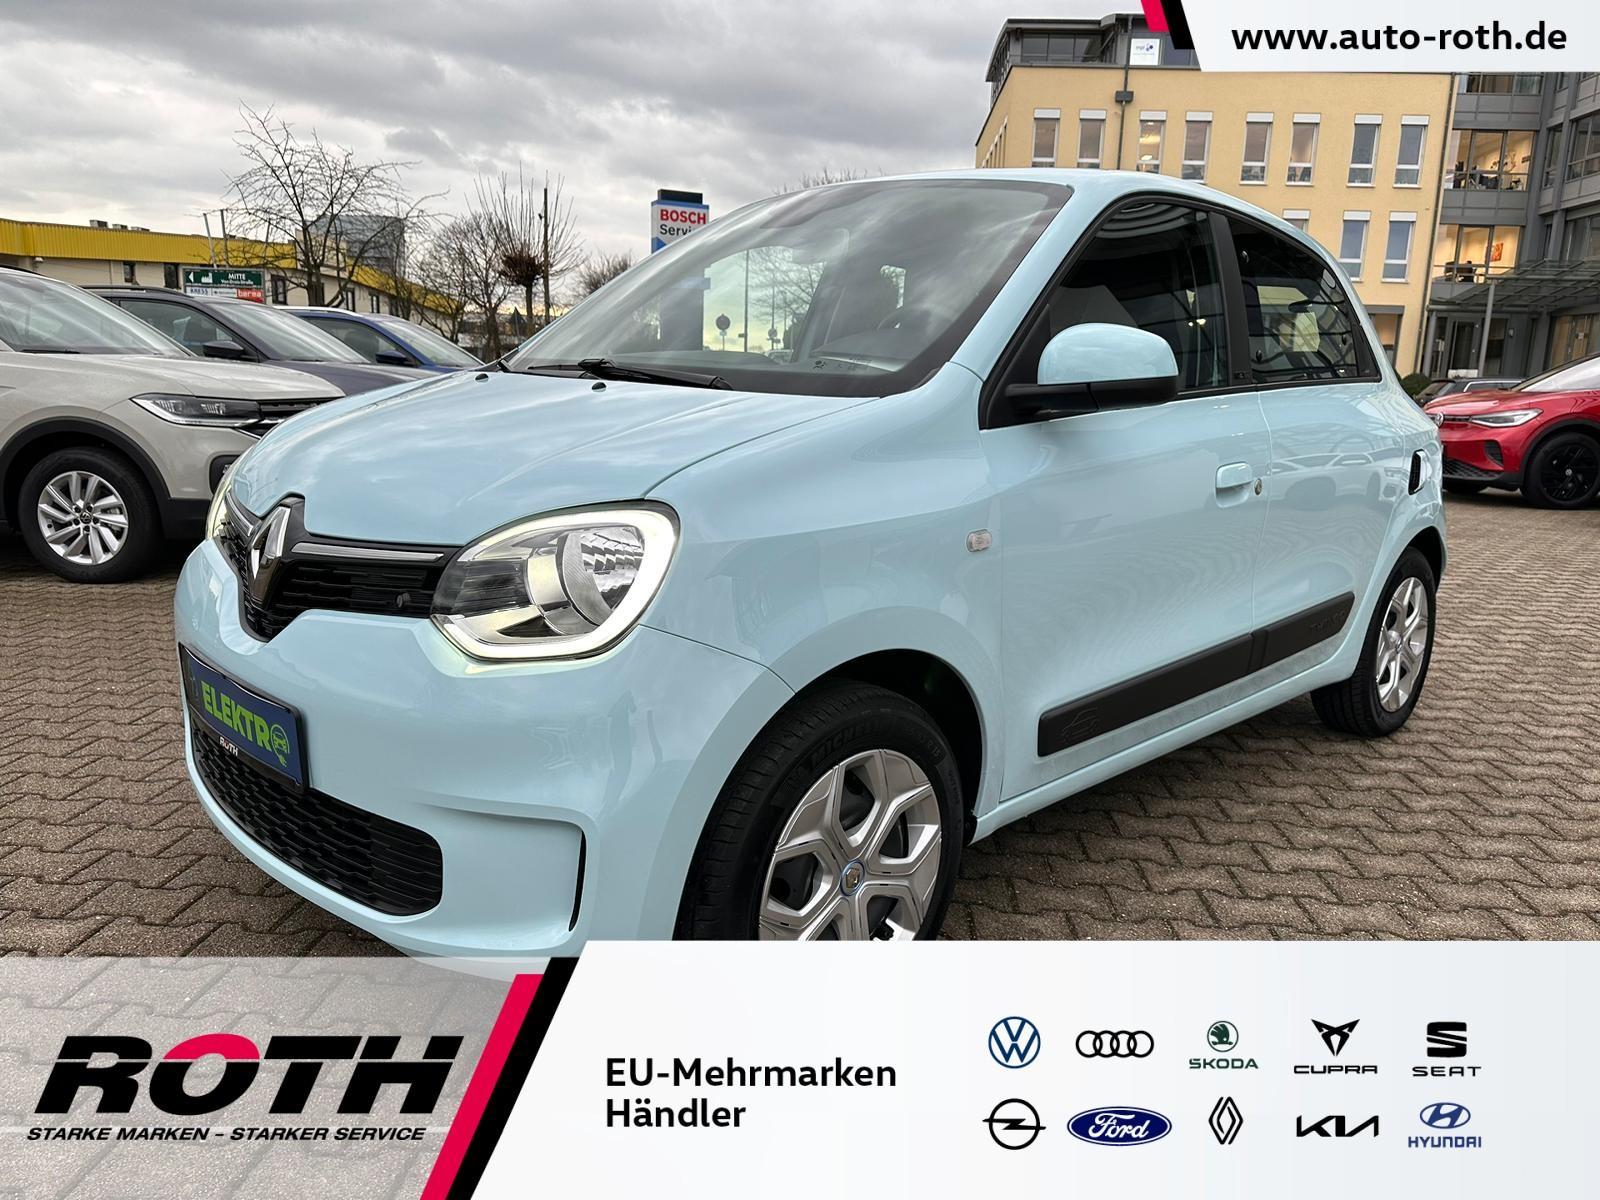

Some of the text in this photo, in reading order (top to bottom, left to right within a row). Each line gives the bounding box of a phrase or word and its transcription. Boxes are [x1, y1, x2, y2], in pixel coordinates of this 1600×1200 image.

[660, 208, 706, 224] BOSCH
[660, 224, 692, 236] Servi
[219, 736, 239, 757] ROTH
